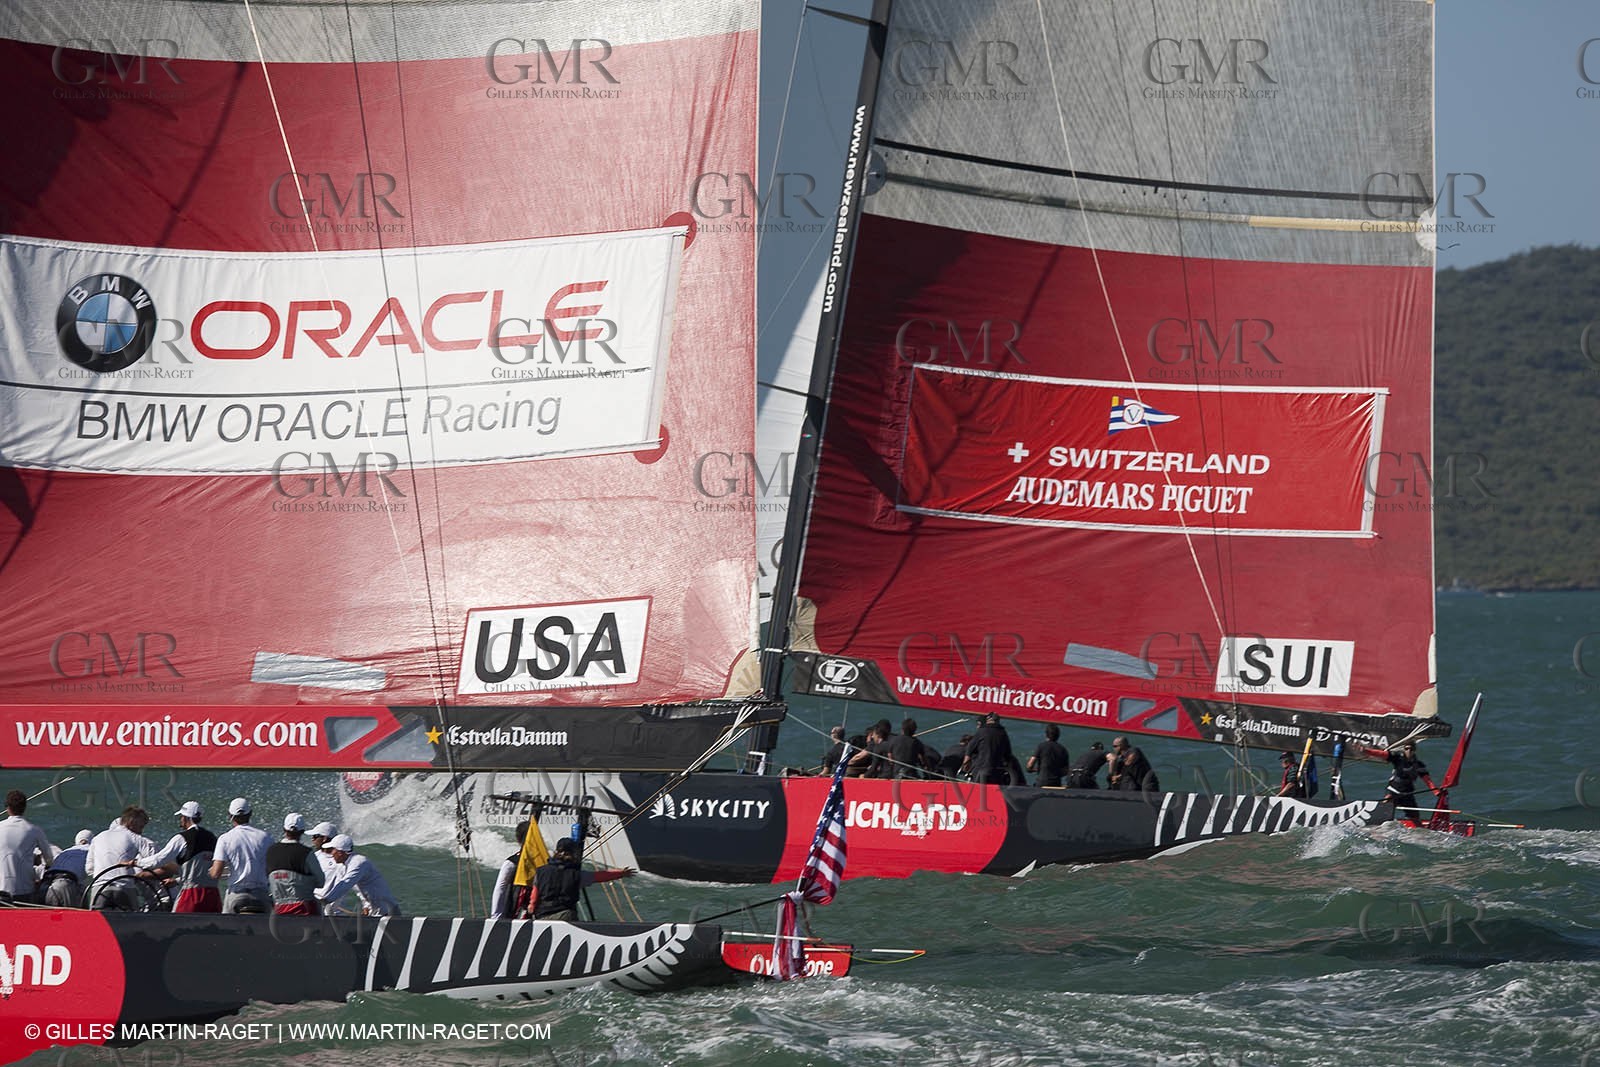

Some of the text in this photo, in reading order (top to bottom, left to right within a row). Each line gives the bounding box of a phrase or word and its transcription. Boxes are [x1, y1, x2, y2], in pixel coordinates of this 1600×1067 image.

[823, 105, 866, 313] www.newzealand.com
[68, 276, 151, 310] BMW
[190, 280, 609, 360] ORACLE
[77, 391, 562, 443] BMW ORACLE Racing
[1048, 446, 1271, 475] SWITZERLAND
[1005, 476, 1253, 514] AUDEMARS PIGUET
[475, 612, 627, 683] USA
[1239, 643, 1332, 688] SUI
[896, 676, 1109, 718] www.emirates.com
[15, 715, 318, 747] www.emirates.com
[679, 798, 770, 819] SKYCITY
